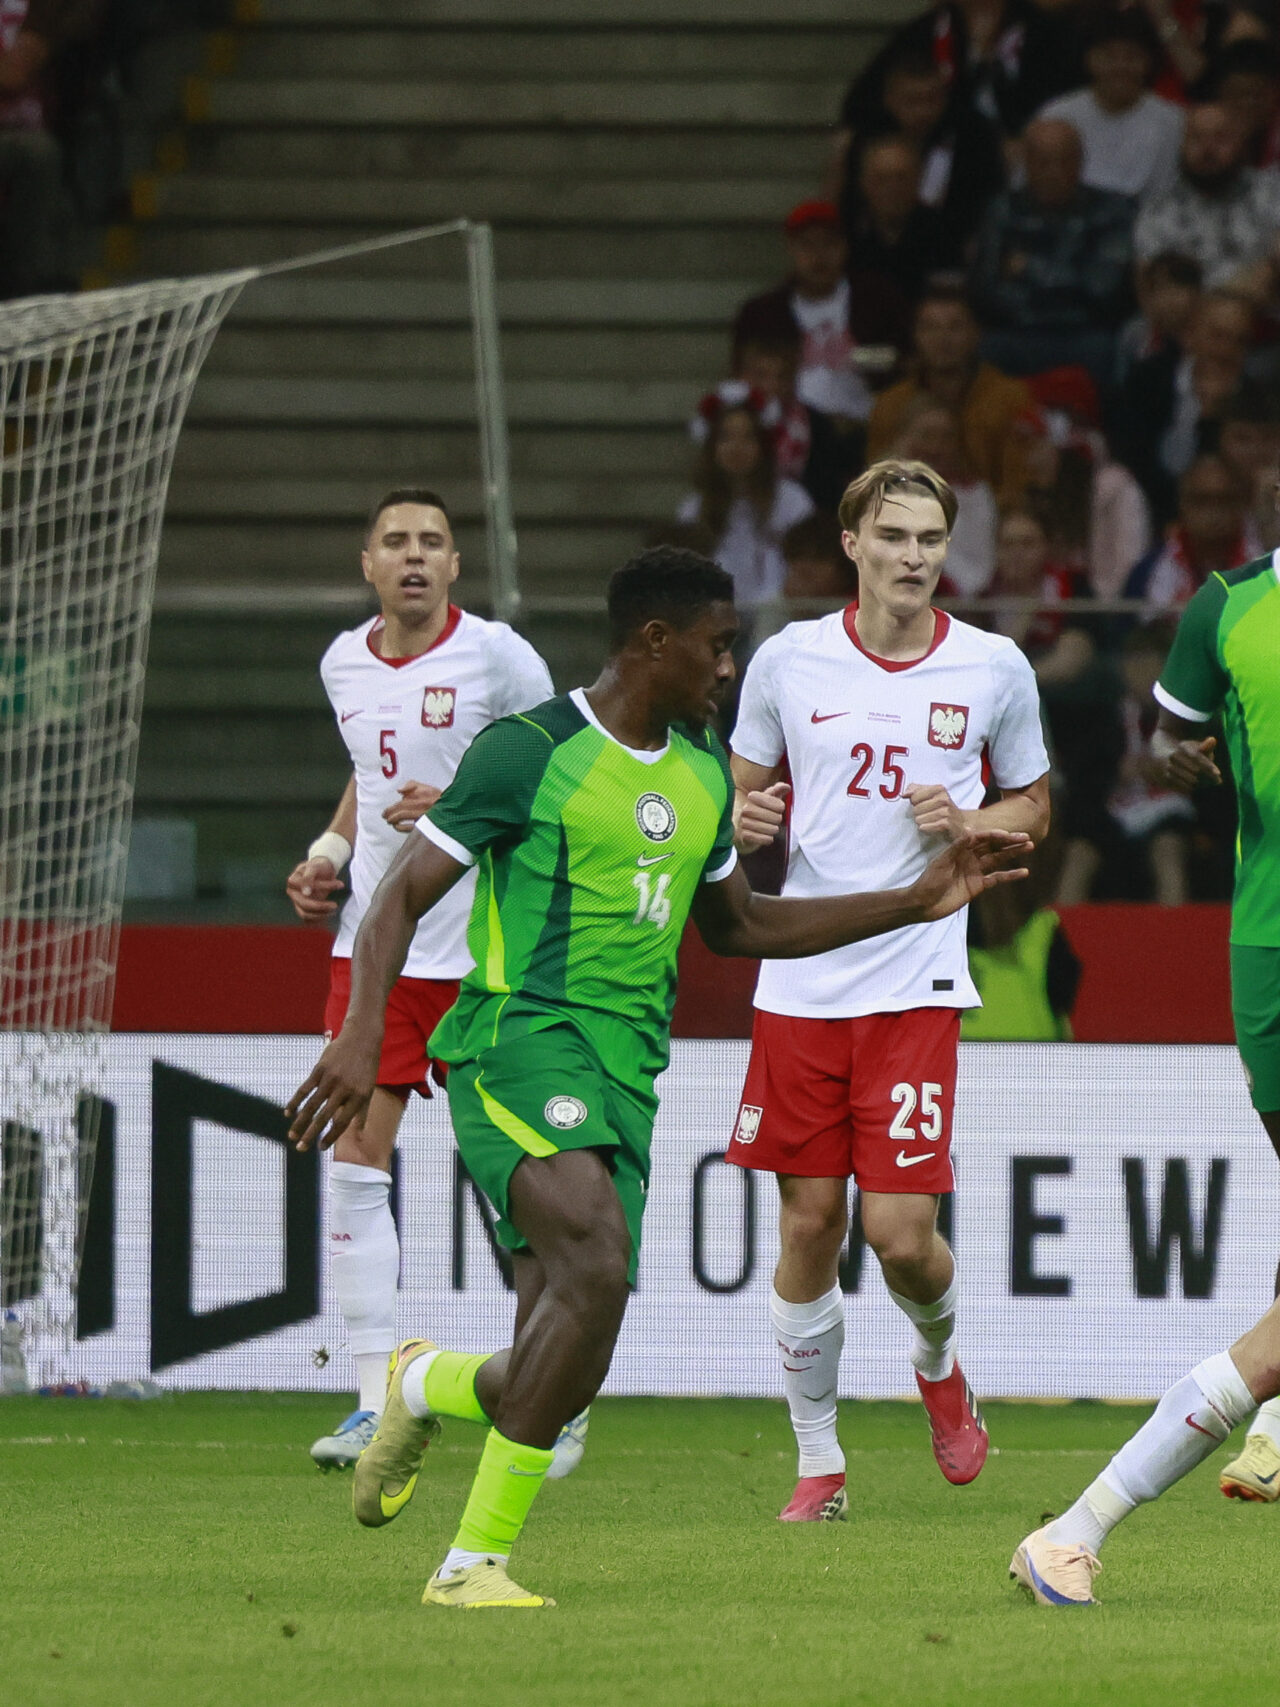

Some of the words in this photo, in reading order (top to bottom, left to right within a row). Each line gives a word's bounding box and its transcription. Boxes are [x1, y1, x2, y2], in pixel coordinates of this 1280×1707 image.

[379, 729, 398, 779] 5
[847, 742, 909, 802] 25
[632, 872, 672, 931] 14
[889, 1082, 943, 1141] 25
